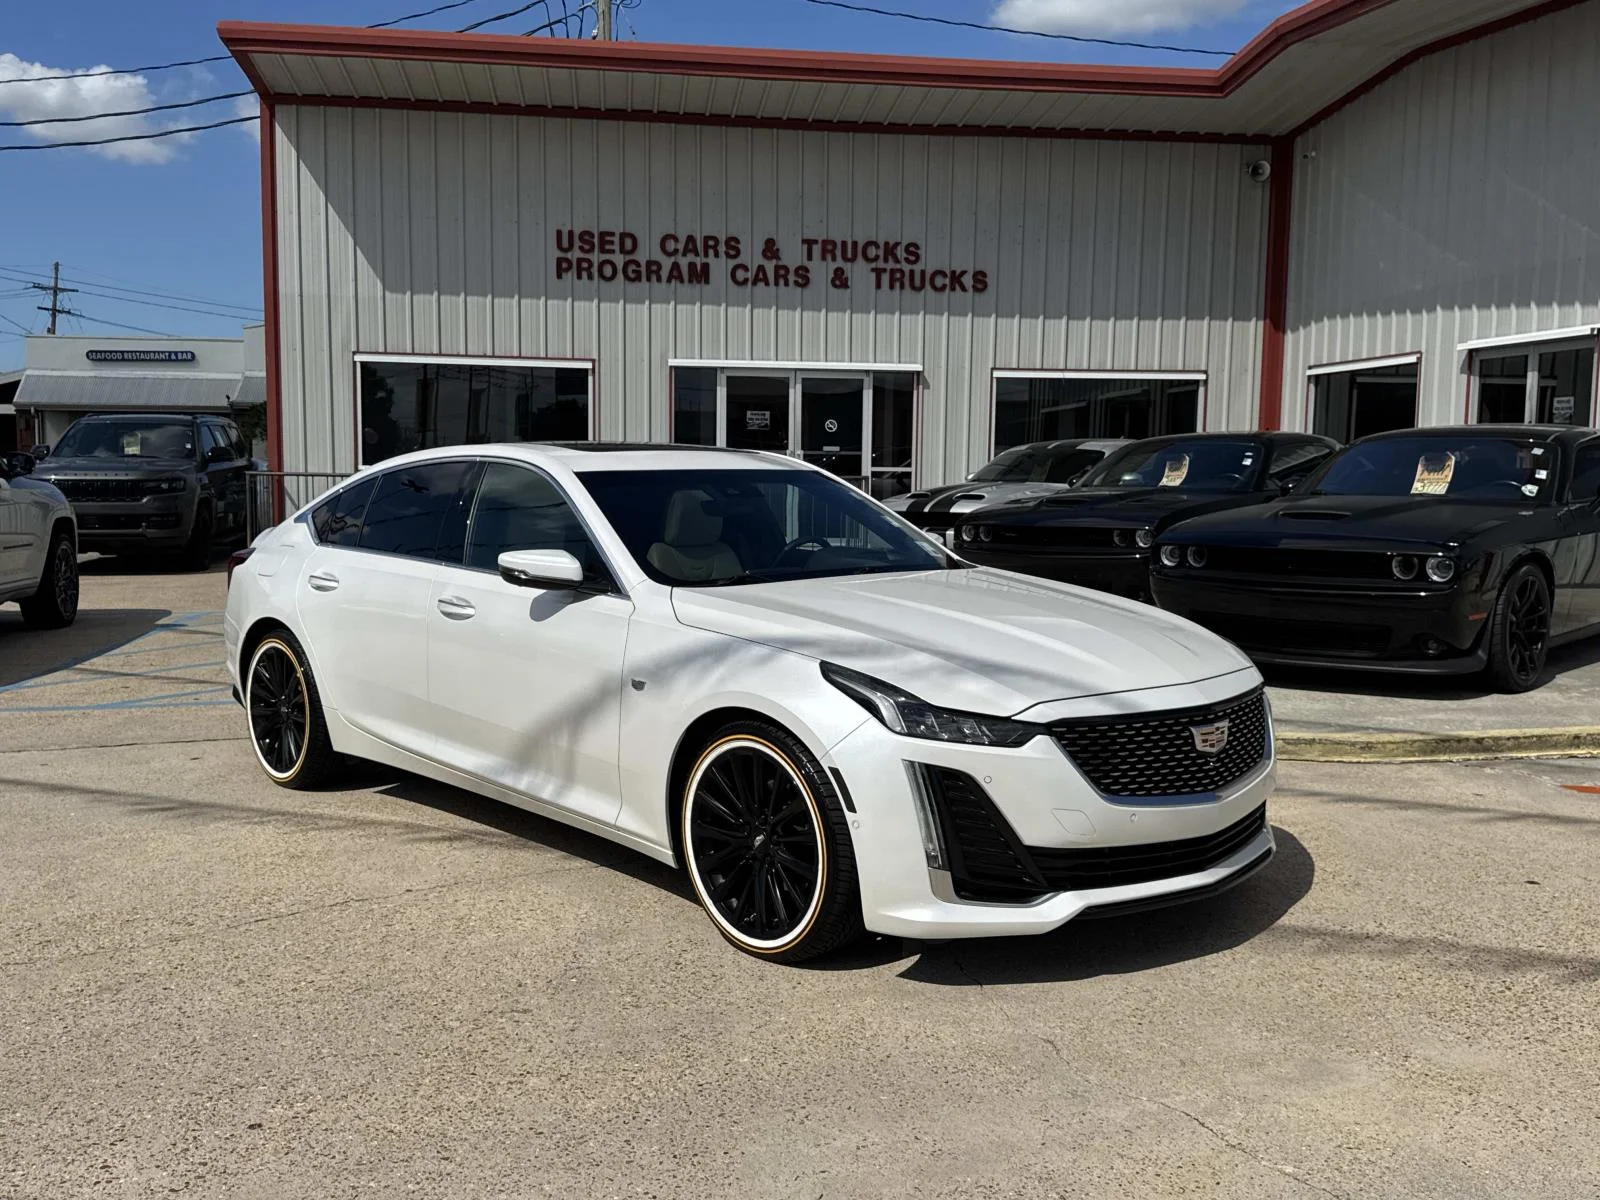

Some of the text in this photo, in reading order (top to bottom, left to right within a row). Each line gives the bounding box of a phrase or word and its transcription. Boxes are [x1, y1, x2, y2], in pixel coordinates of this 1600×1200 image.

[555, 230, 922, 265] USED CARS & TRUCKS
[556, 257, 989, 293] PROGRAM CARS & TRUCKS
[88, 352, 193, 360] SEAFOOD RESTAURANT & BAR
